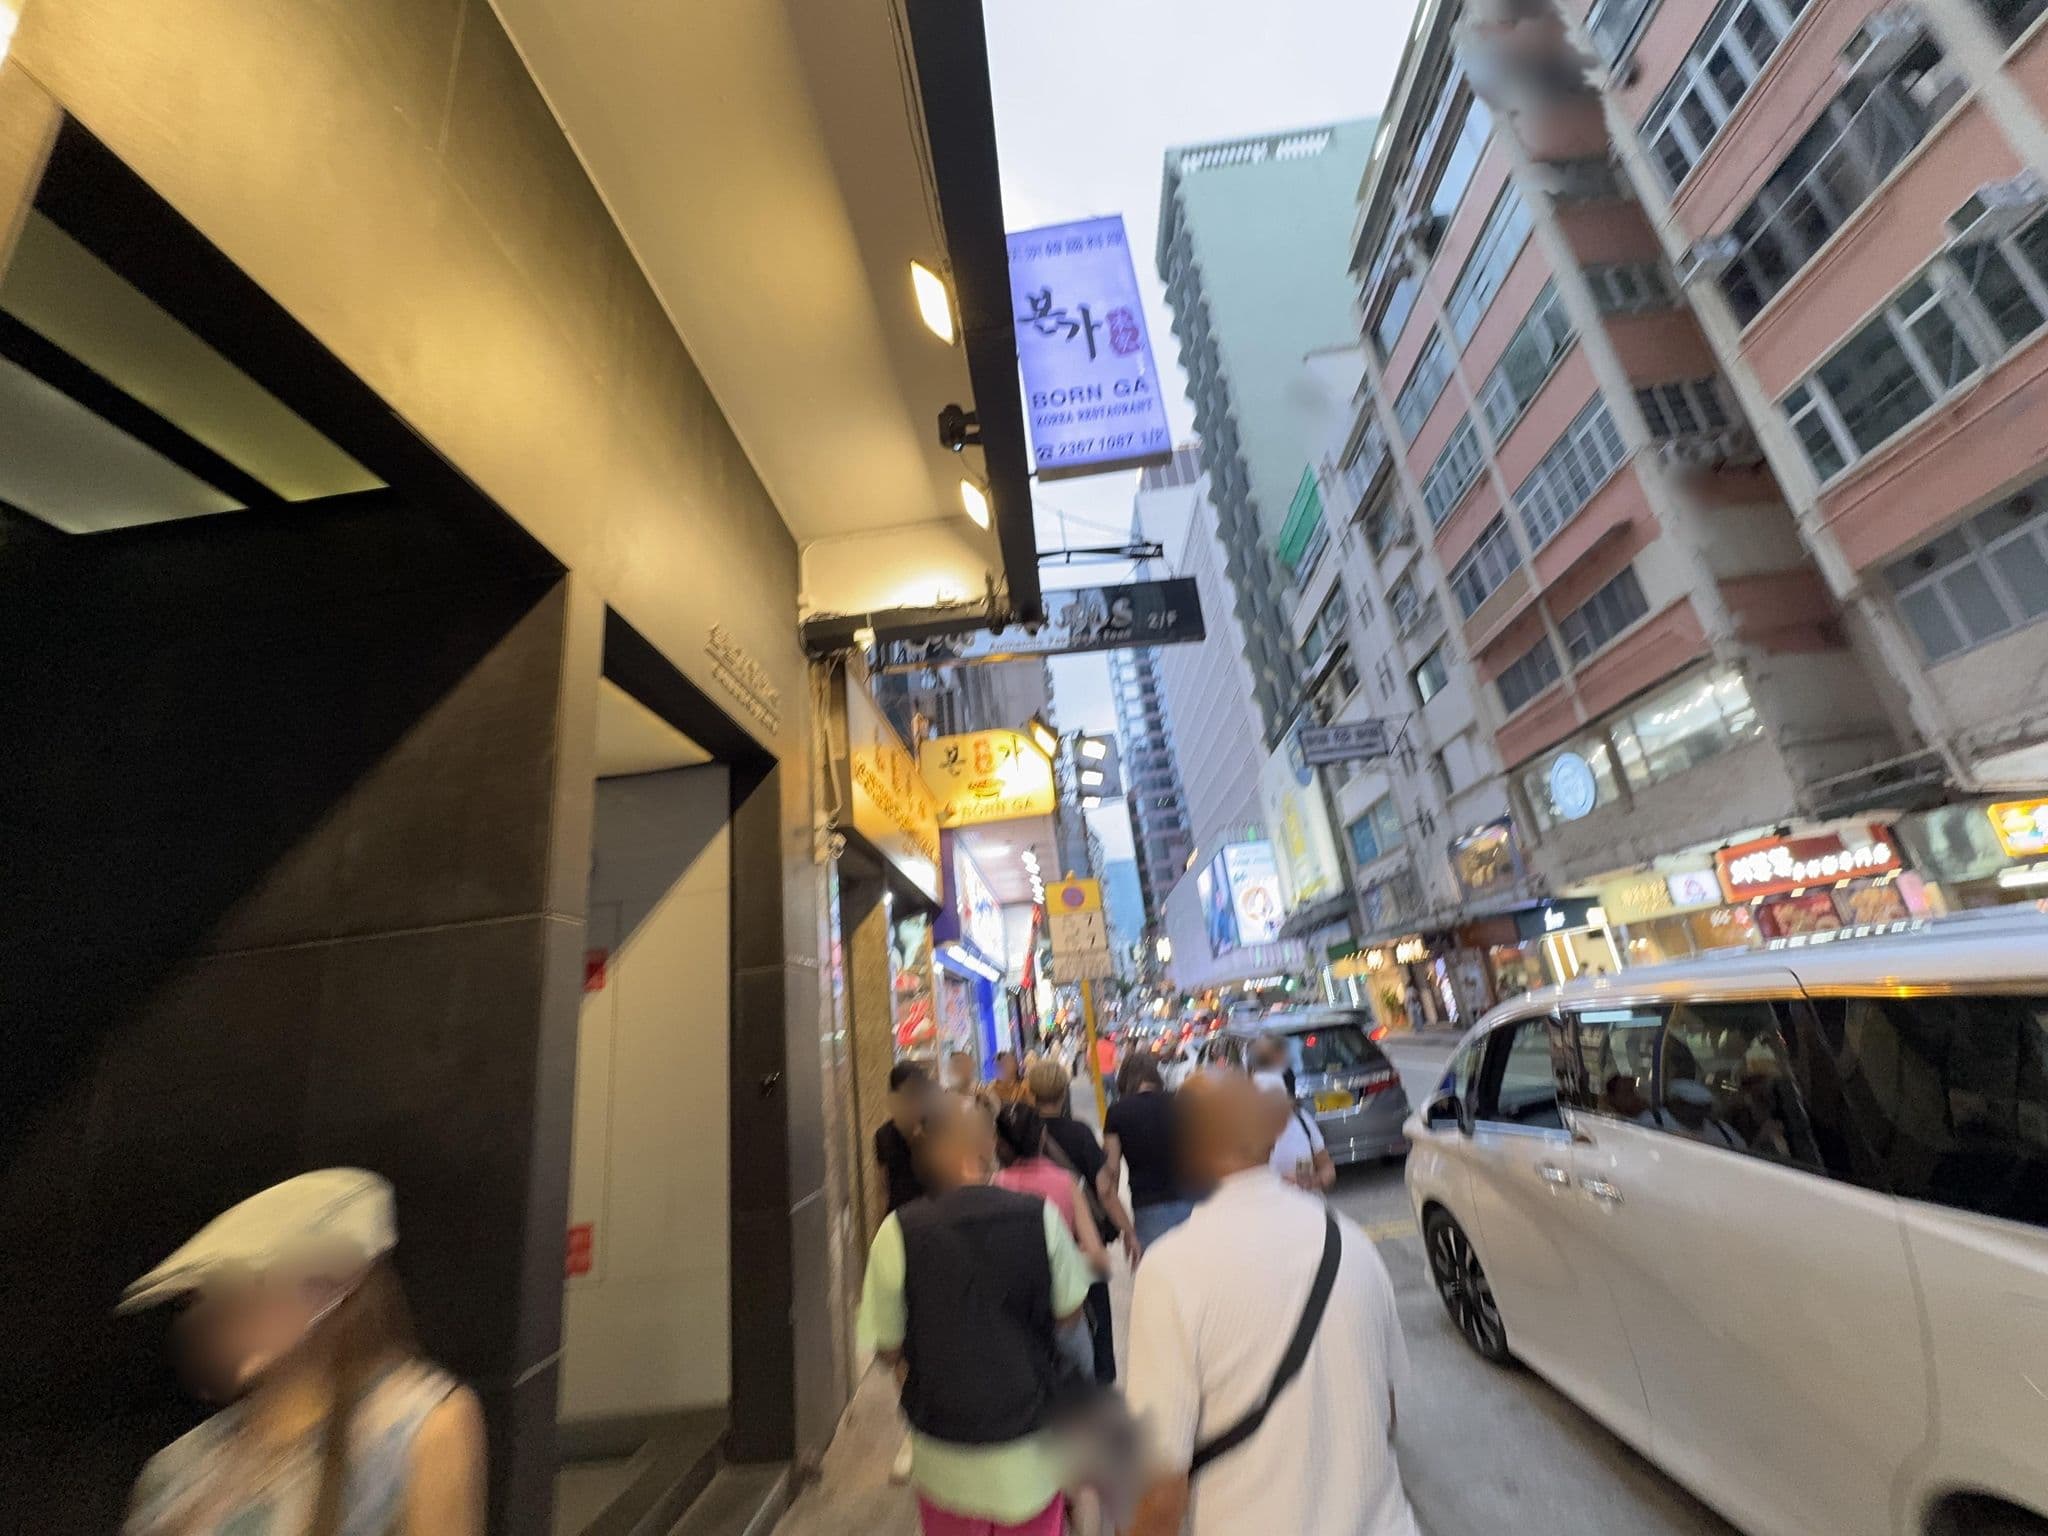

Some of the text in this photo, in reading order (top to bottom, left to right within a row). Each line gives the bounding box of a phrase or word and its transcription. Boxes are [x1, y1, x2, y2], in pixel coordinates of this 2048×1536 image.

[1032, 376, 1149, 409] BORN GA
[1147, 608, 1178, 630] 2/F
